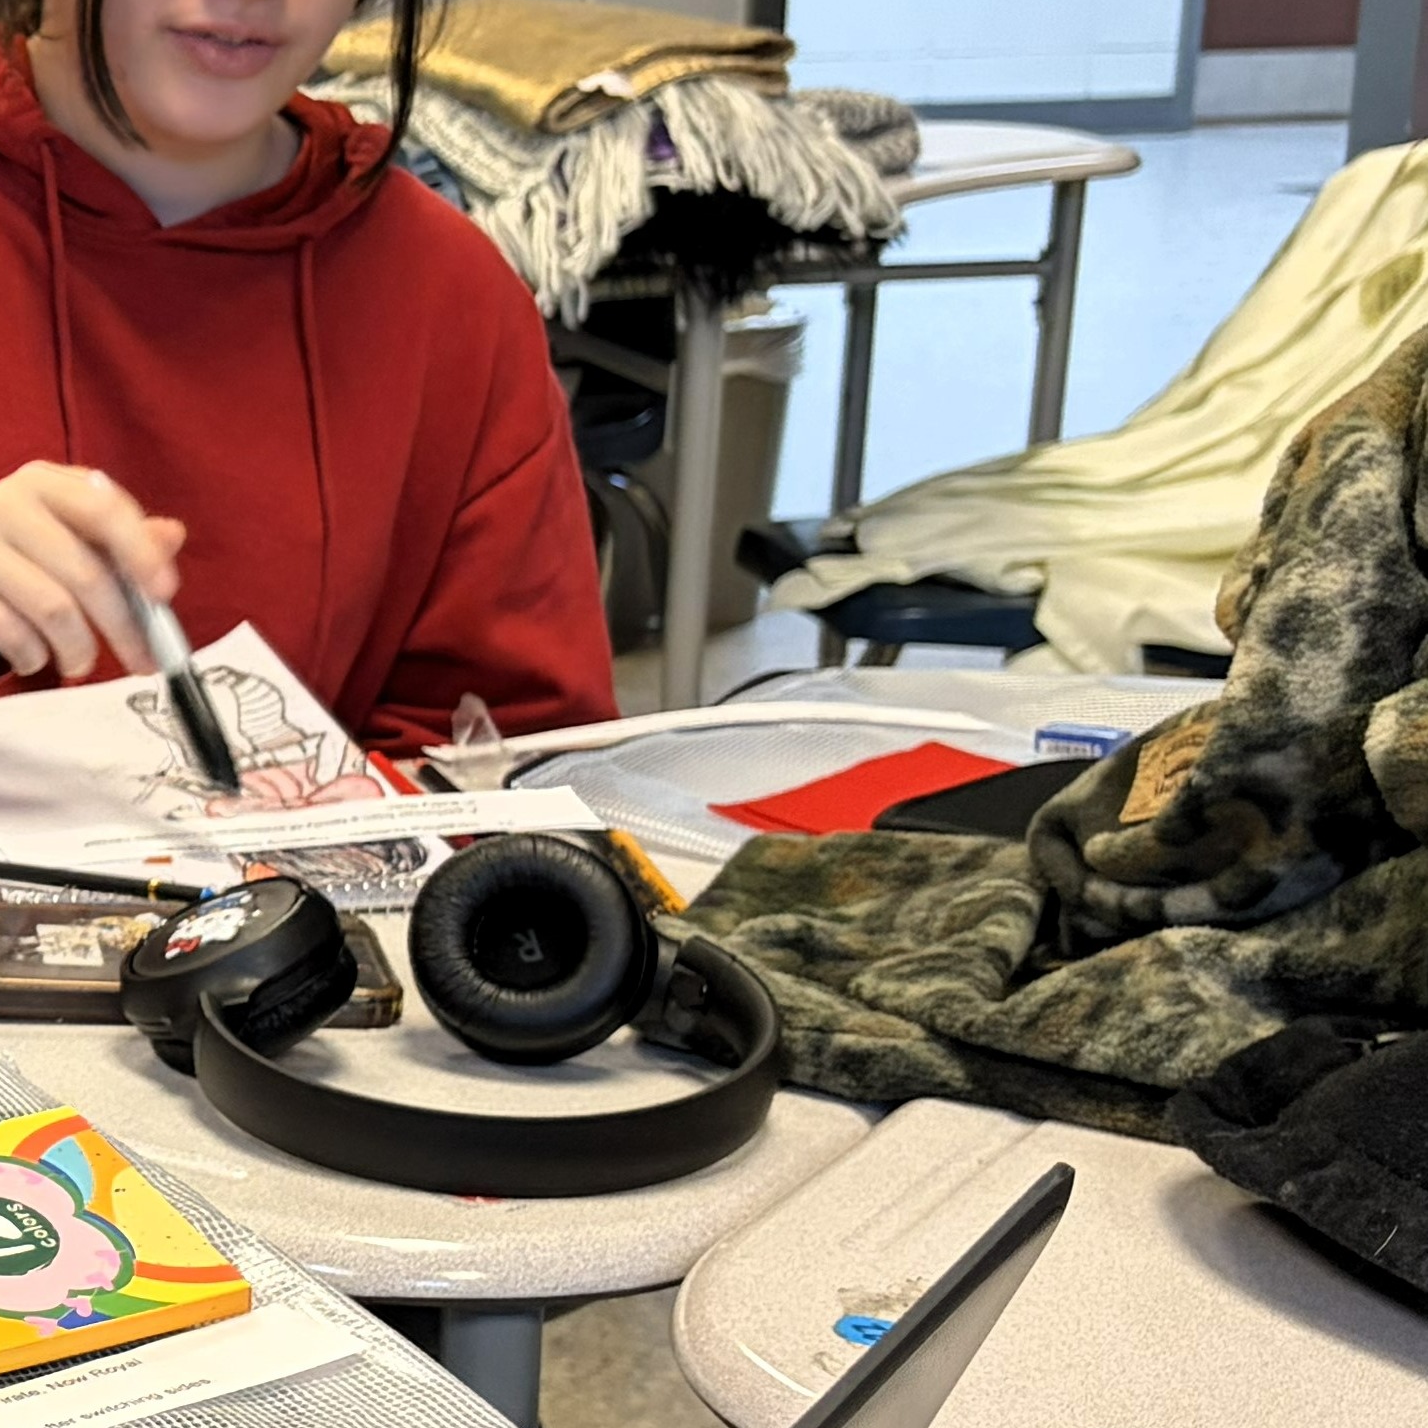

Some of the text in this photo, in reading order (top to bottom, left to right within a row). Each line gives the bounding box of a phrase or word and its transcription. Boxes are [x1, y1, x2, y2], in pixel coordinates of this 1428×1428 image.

[46, 1374, 88, 1391] Now
[89, 1357, 143, 1380] Royal
[80, 1391, 164, 1421] switching
